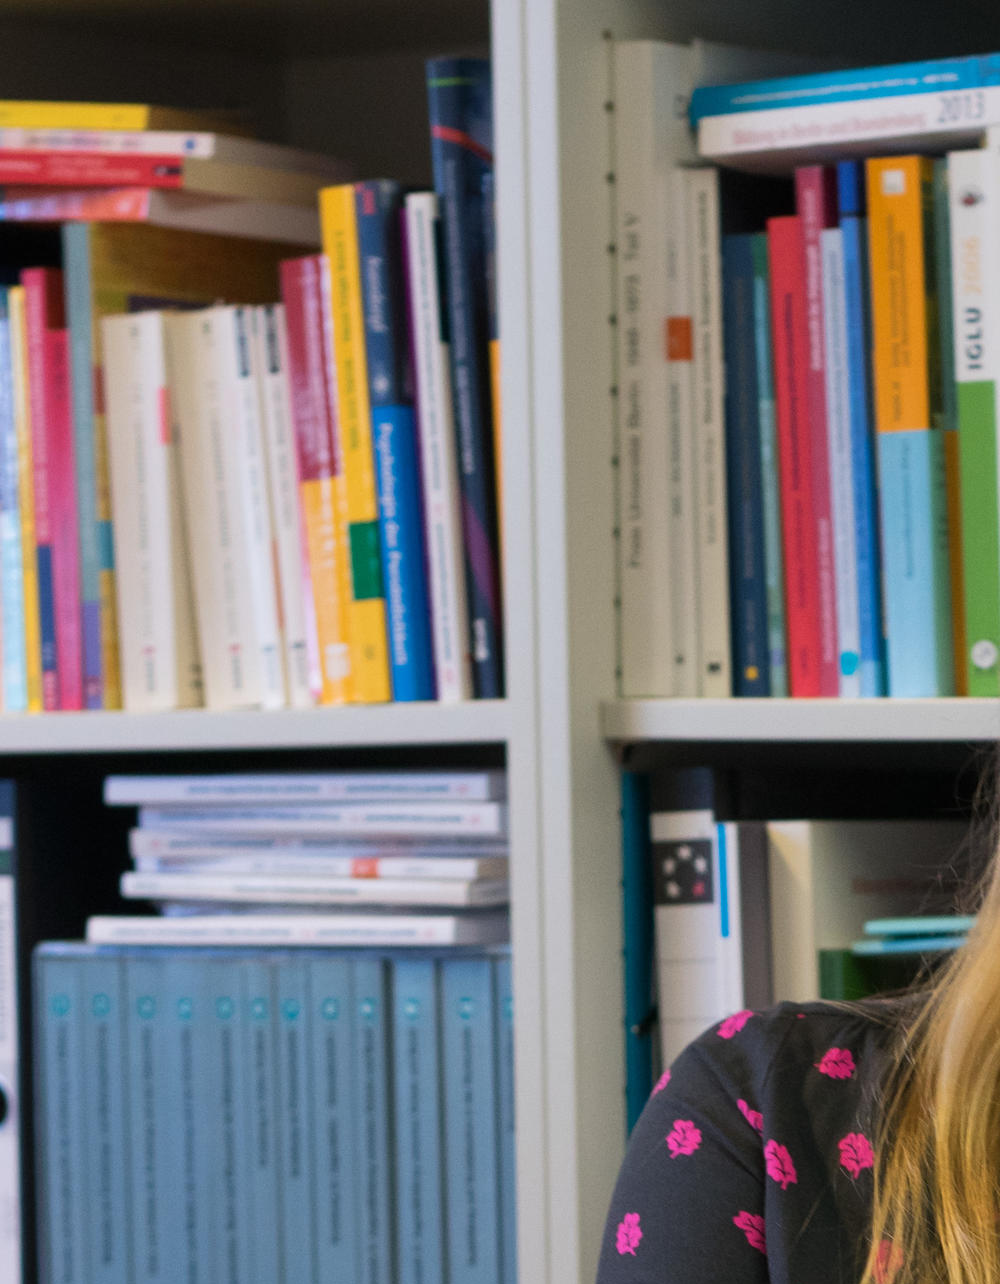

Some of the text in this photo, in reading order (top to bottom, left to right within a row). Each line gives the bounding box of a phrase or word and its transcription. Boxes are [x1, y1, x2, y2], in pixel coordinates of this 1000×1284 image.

[935, 93, 985, 125] 2013
[961, 237, 983, 370] IGLU 2006
[373, 423, 397, 519] Psychologie
[382, 523, 399, 549] der
[387, 553, 407, 665] Persönlichkeit
